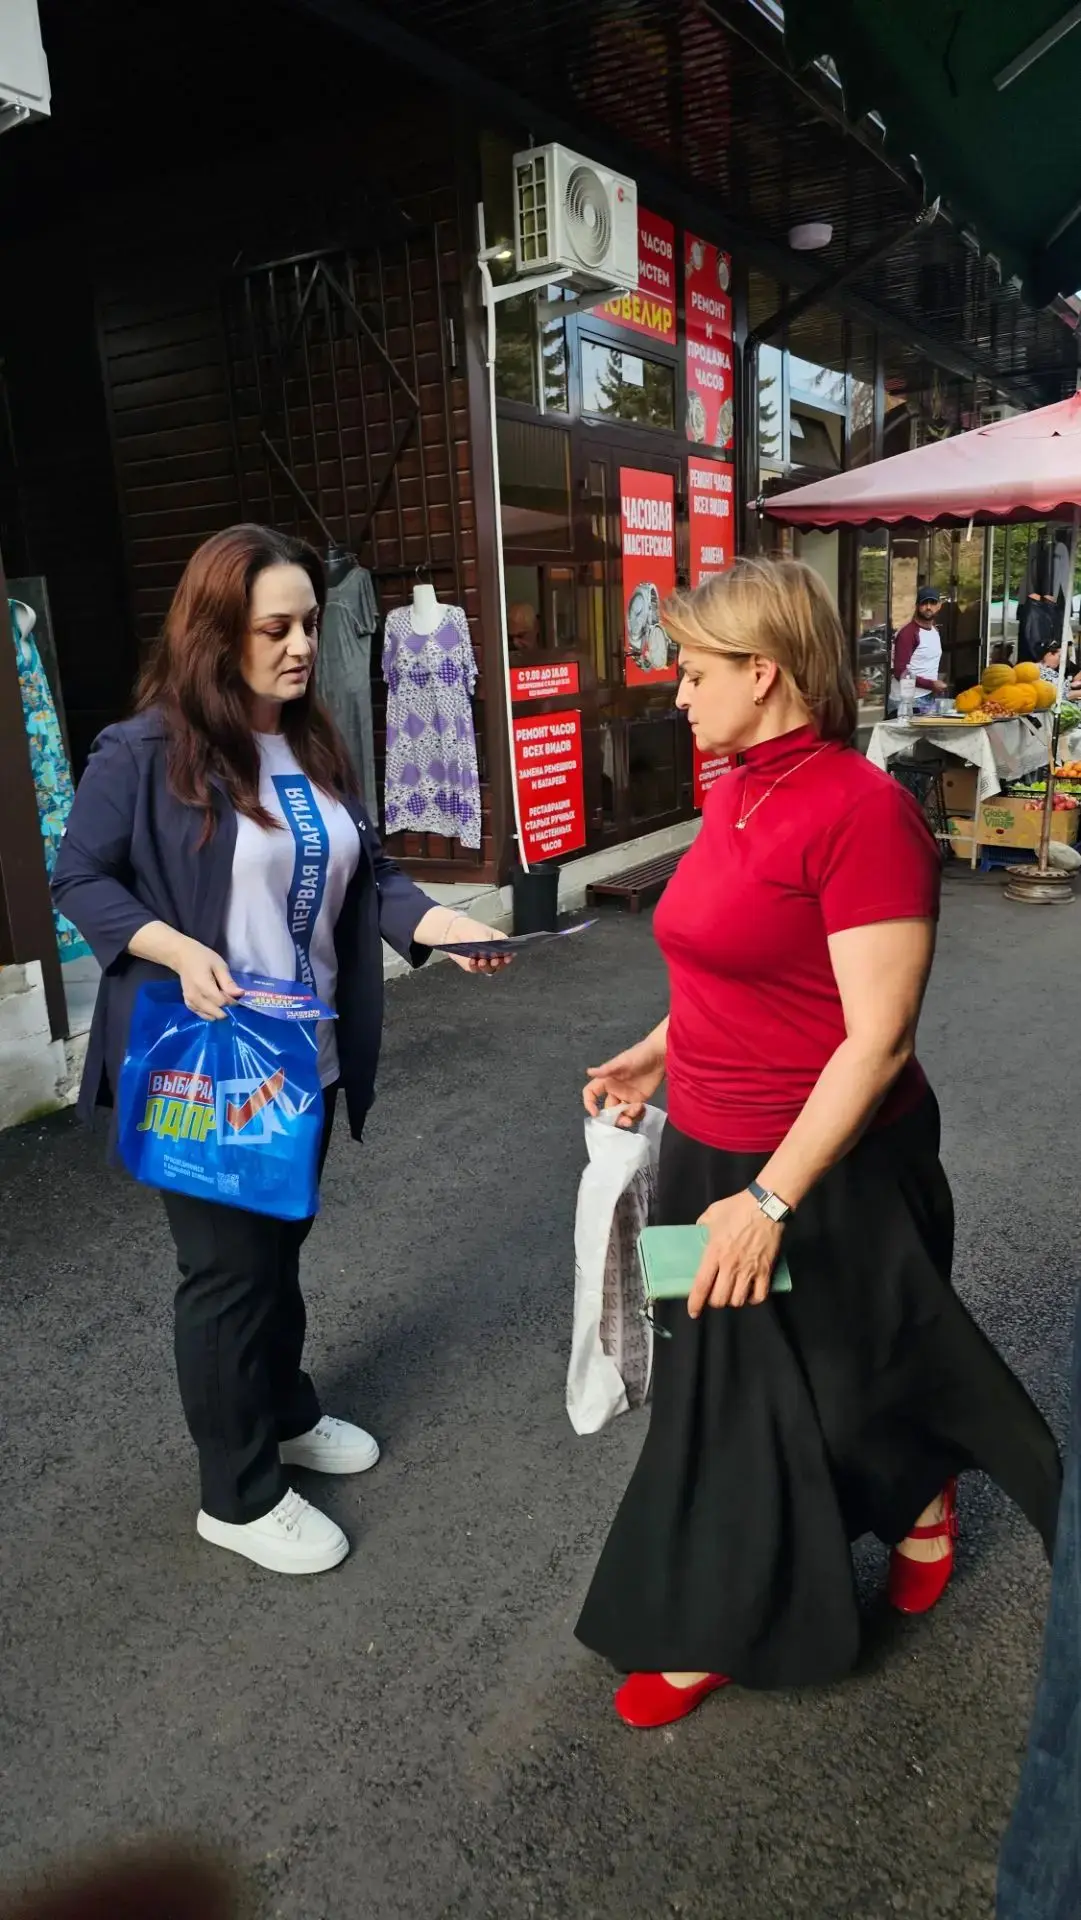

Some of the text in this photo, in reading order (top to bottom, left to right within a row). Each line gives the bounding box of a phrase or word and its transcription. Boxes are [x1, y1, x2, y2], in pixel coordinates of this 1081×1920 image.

[641, 230, 672, 260] ЧАСОВ
[638, 259, 670, 288] ИСТЕМ
[691, 291, 726, 320] РЕМОНТ
[706, 322, 713, 340] И
[687, 340, 731, 370] ПРОДАЖА
[695, 367, 724, 391] ЧАСОВ
[690, 469, 732, 493] РЕМОНТ ЧАСОВ
[622, 496, 672, 531] ЧАСОВАЯ
[694, 495, 729, 517] ВСЕХ ВИДОВ
[623, 533, 672, 557] МАСТЕРСКАЯ
[701, 546, 724, 564] ЗАМЕНА
[518, 671, 525, 682] С
[541, 668, 551, 680] ДО
[516, 722, 576, 742] РЕМОНТ ЧАСОВ
[523, 740, 572, 758] ВСЕХ ВИДОВ
[519, 766, 543, 780] ЗАМЕНА
[531, 775, 567, 790] И БАТАРЕЕК
[284, 787, 322, 857] ПАРТИЯ
[525, 810, 575, 831] СТАРЫХ РУЧНЫХ
[535, 824, 572, 842] НАСТЕННЫХ
[541, 838, 563, 852] ЧАСОВ
[292, 865, 320, 933] ПЕРВАЯ
[136, 1097, 216, 1143] ЛДПР
